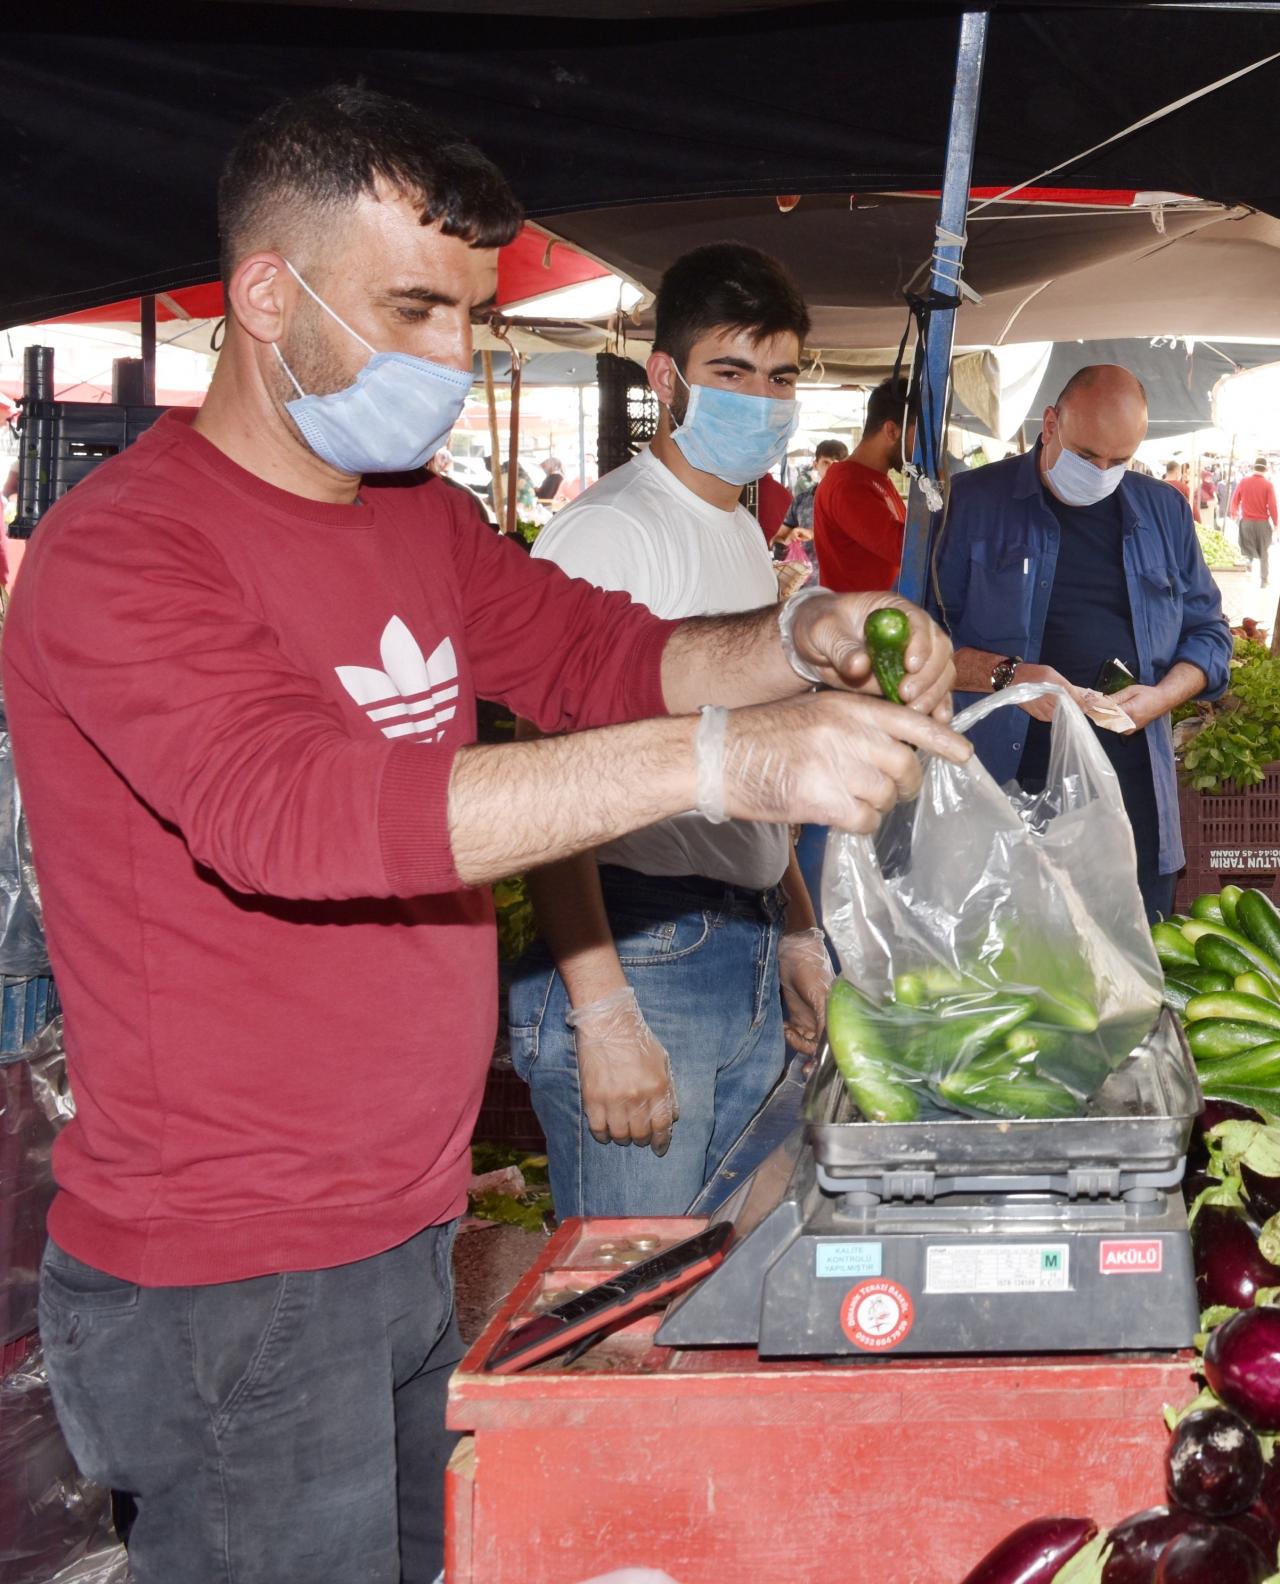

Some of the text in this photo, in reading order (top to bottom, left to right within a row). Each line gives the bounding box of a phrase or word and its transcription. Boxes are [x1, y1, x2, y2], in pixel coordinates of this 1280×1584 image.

[1210, 857, 1245, 868] TARIM
[1045, 1255, 1058, 1267] M
[1105, 1248, 1157, 1264] AKÜLÜ
